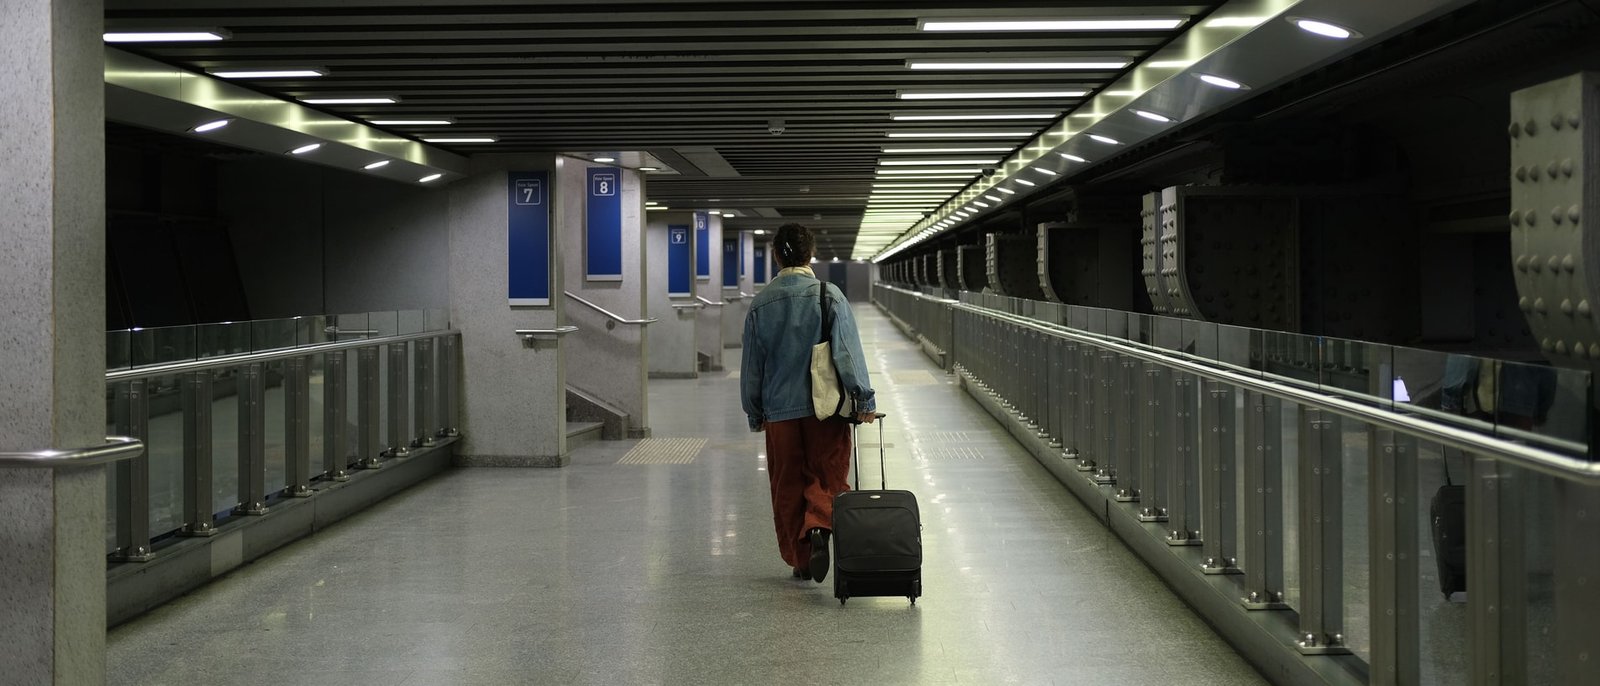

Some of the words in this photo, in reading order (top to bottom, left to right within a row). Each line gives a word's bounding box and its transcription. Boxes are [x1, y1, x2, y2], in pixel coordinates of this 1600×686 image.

[600, 181, 608, 194] 8
[523, 188, 532, 202] 7
[676, 233, 682, 243] 9
